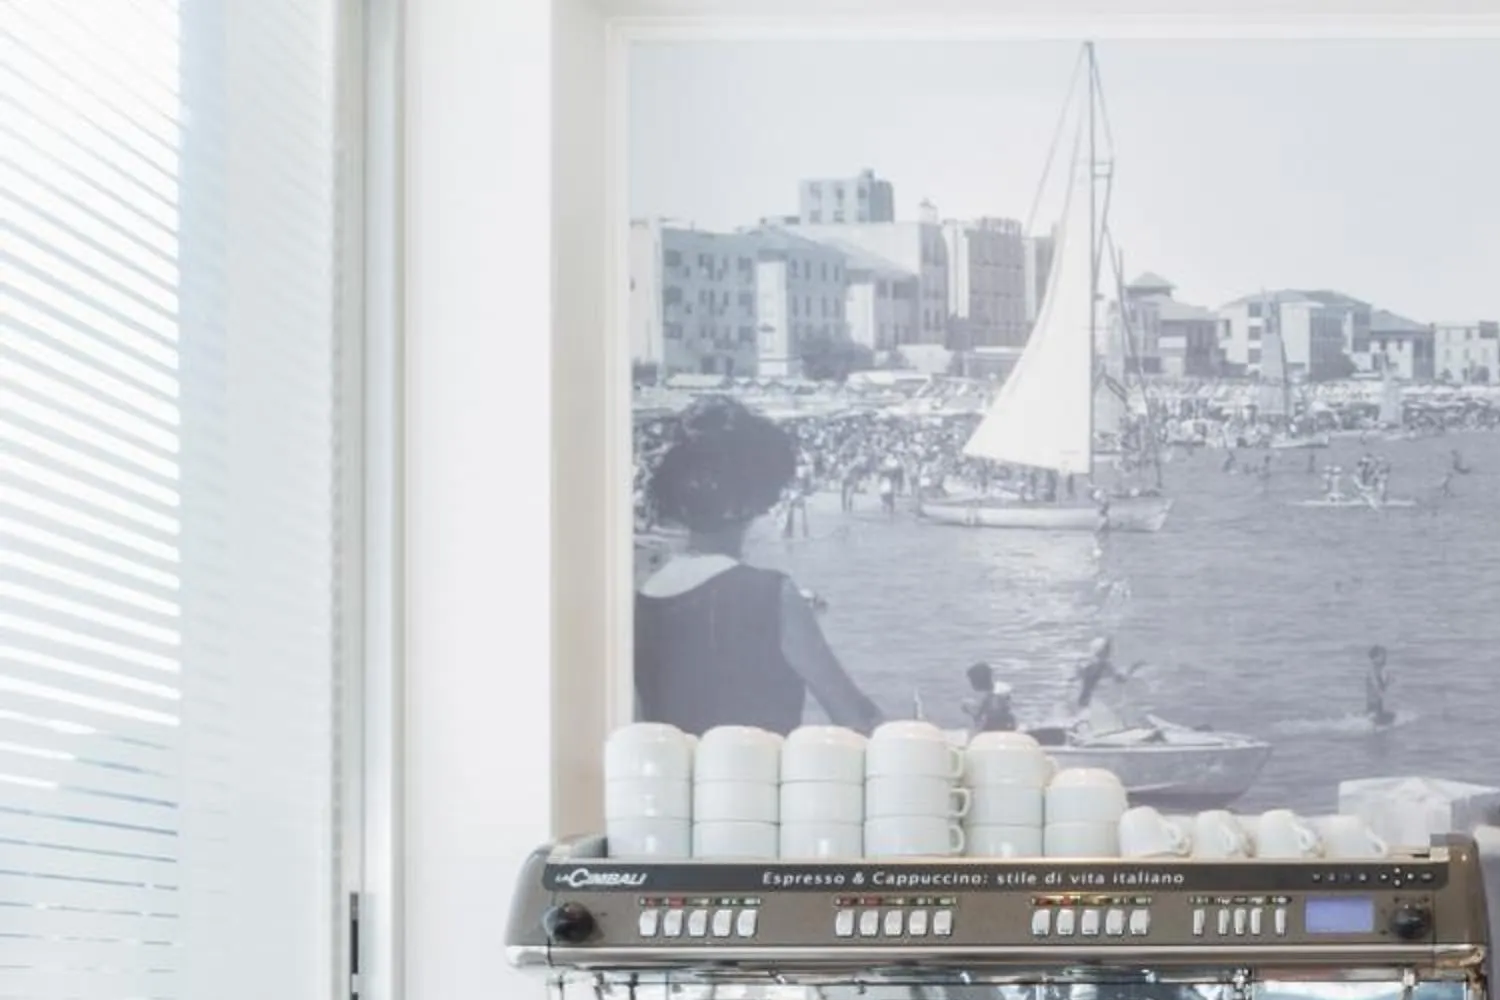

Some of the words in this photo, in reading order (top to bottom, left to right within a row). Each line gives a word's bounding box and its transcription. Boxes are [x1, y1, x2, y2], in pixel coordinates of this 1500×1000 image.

[763, 871, 846, 887] Espresso
[852, 871, 865, 885] &
[872, 871, 988, 887] Cappuccino:
[997, 870, 1038, 885] stile
[1044, 870, 1062, 885] di
[1069, 870, 1106, 885] vita
[1113, 870, 1186, 885] italiano
